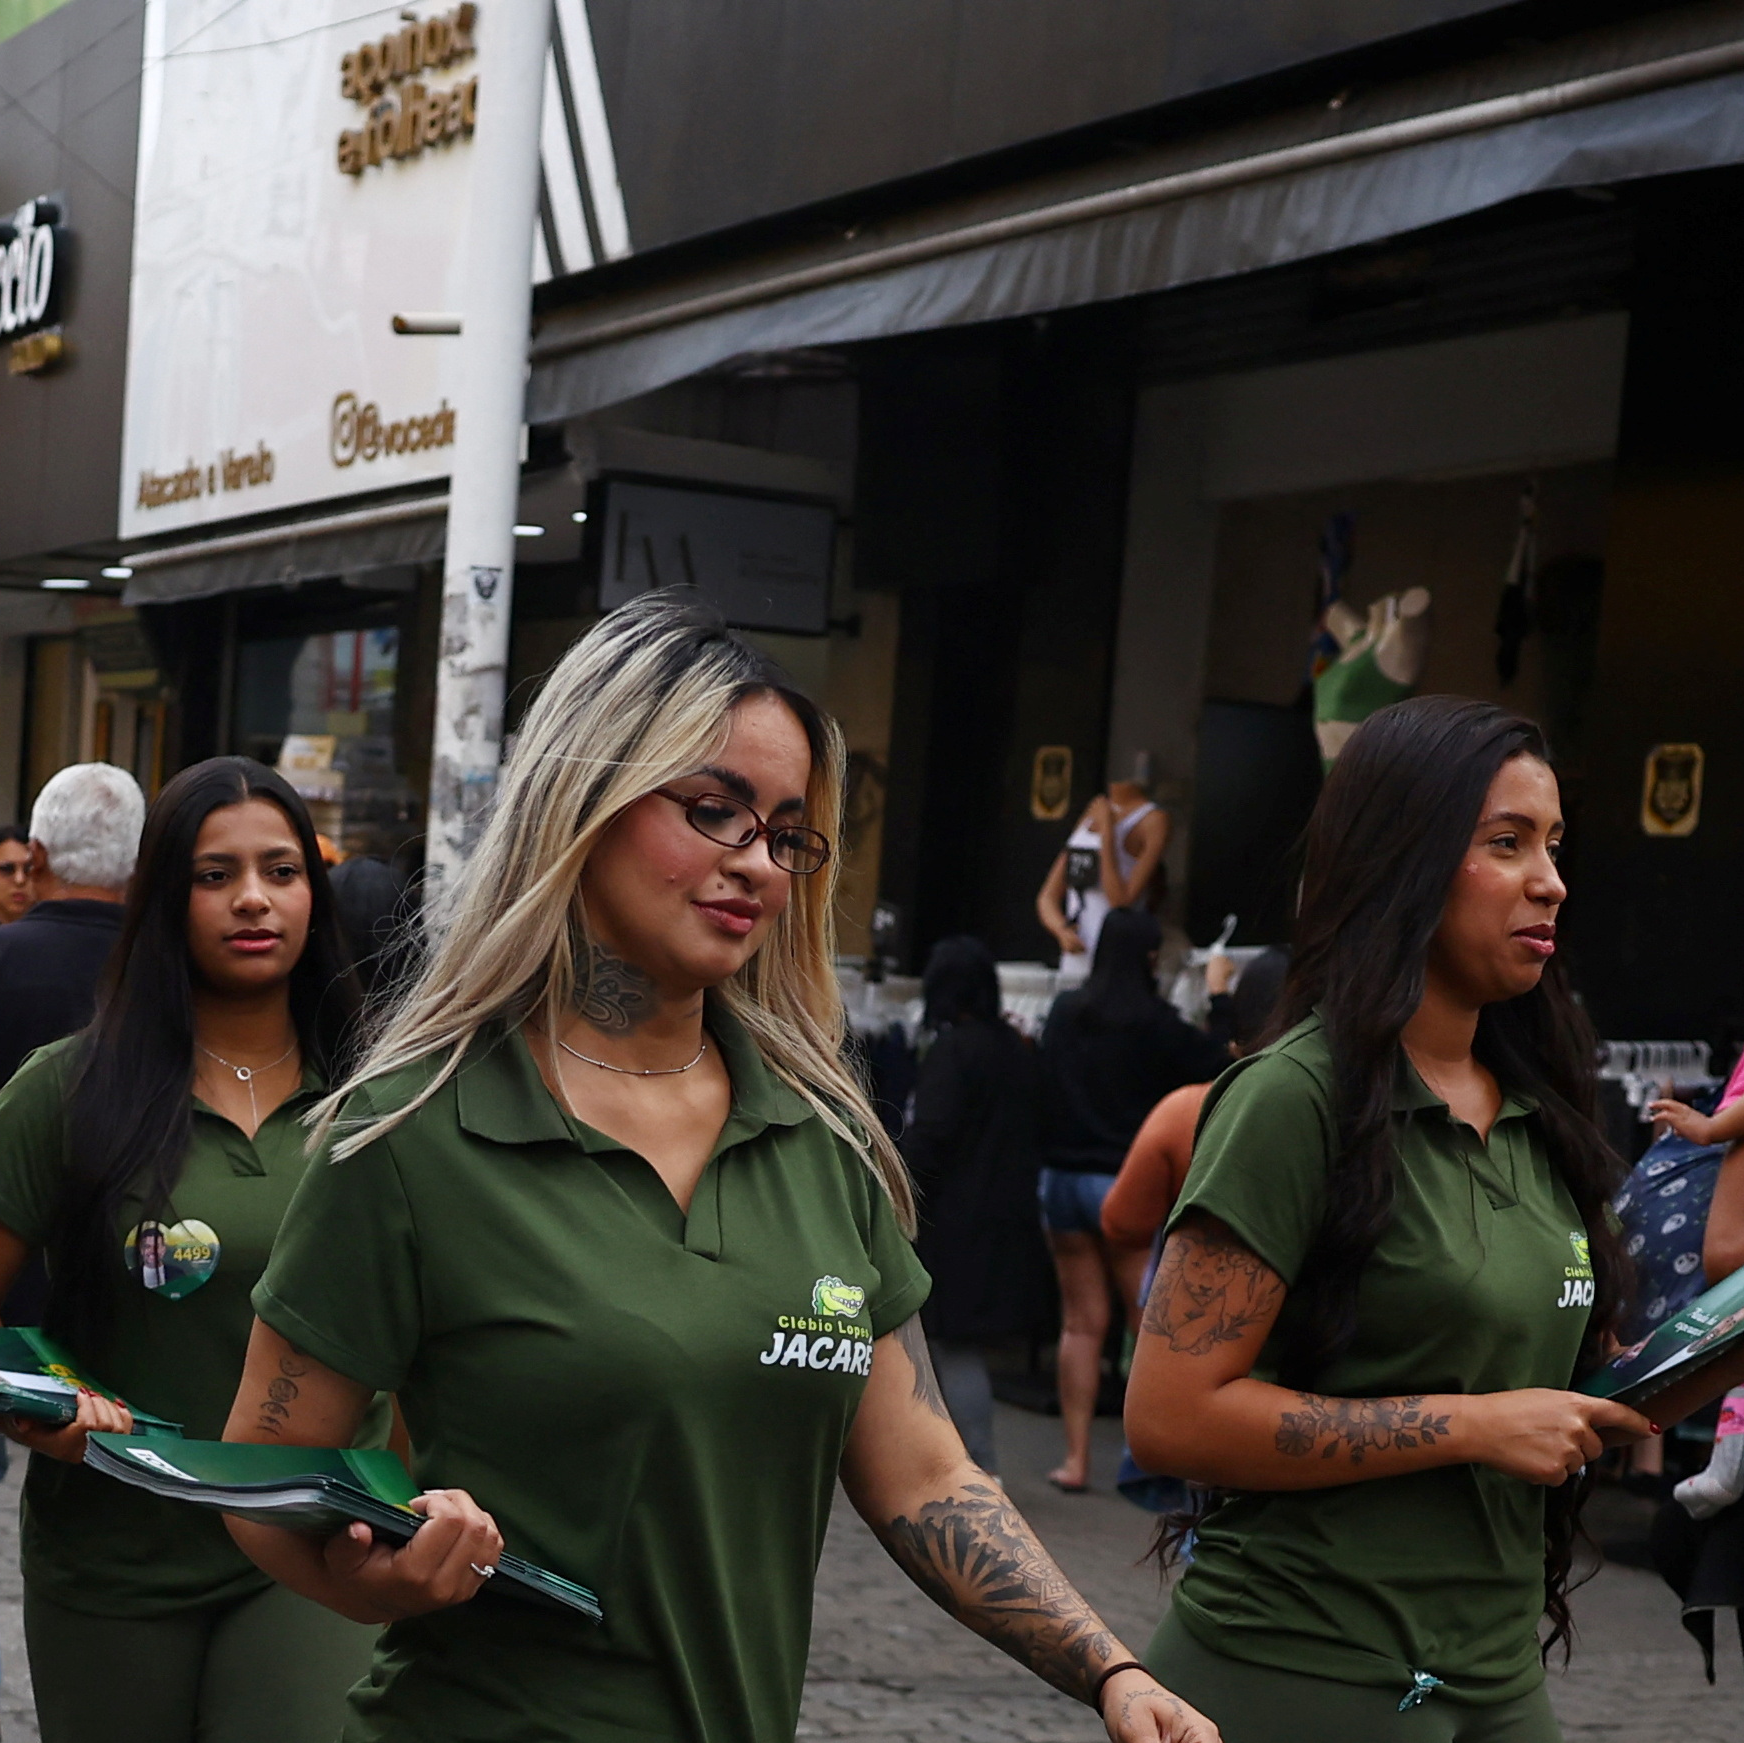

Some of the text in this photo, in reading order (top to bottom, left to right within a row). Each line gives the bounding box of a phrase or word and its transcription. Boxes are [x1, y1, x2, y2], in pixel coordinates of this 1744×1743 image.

[173, 1246, 212, 1262] 4499
[778, 1315, 870, 1339] Clébio Lopes
[760, 1332, 873, 1376] JACARÉ
